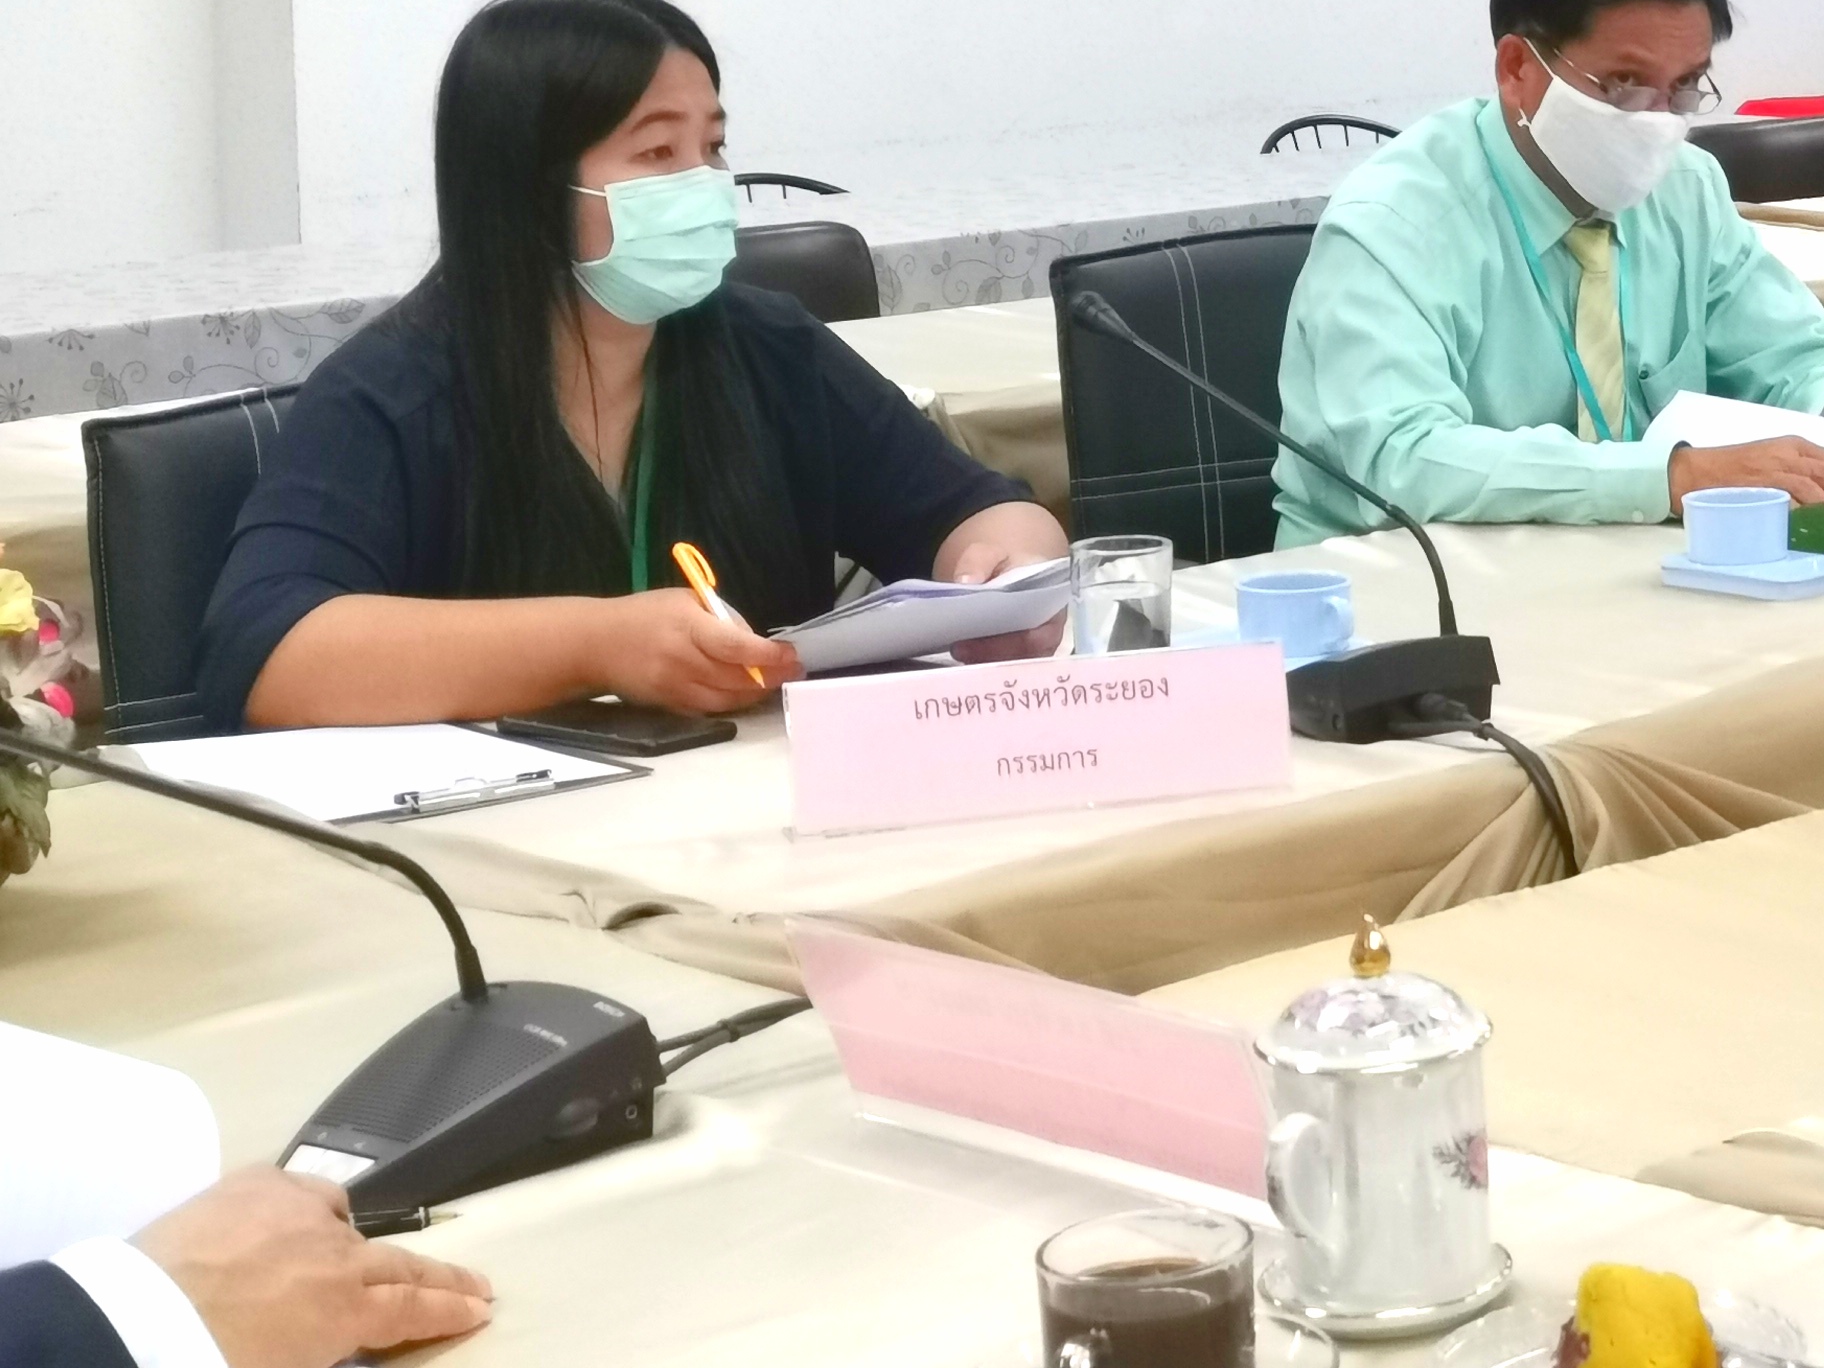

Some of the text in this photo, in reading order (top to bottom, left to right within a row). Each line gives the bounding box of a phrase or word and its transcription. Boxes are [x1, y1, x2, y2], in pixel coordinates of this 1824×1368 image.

[914, 674, 1171, 721] เกษตรจังหวัดระยอง
[996, 747, 1100, 778] กรรมการ
